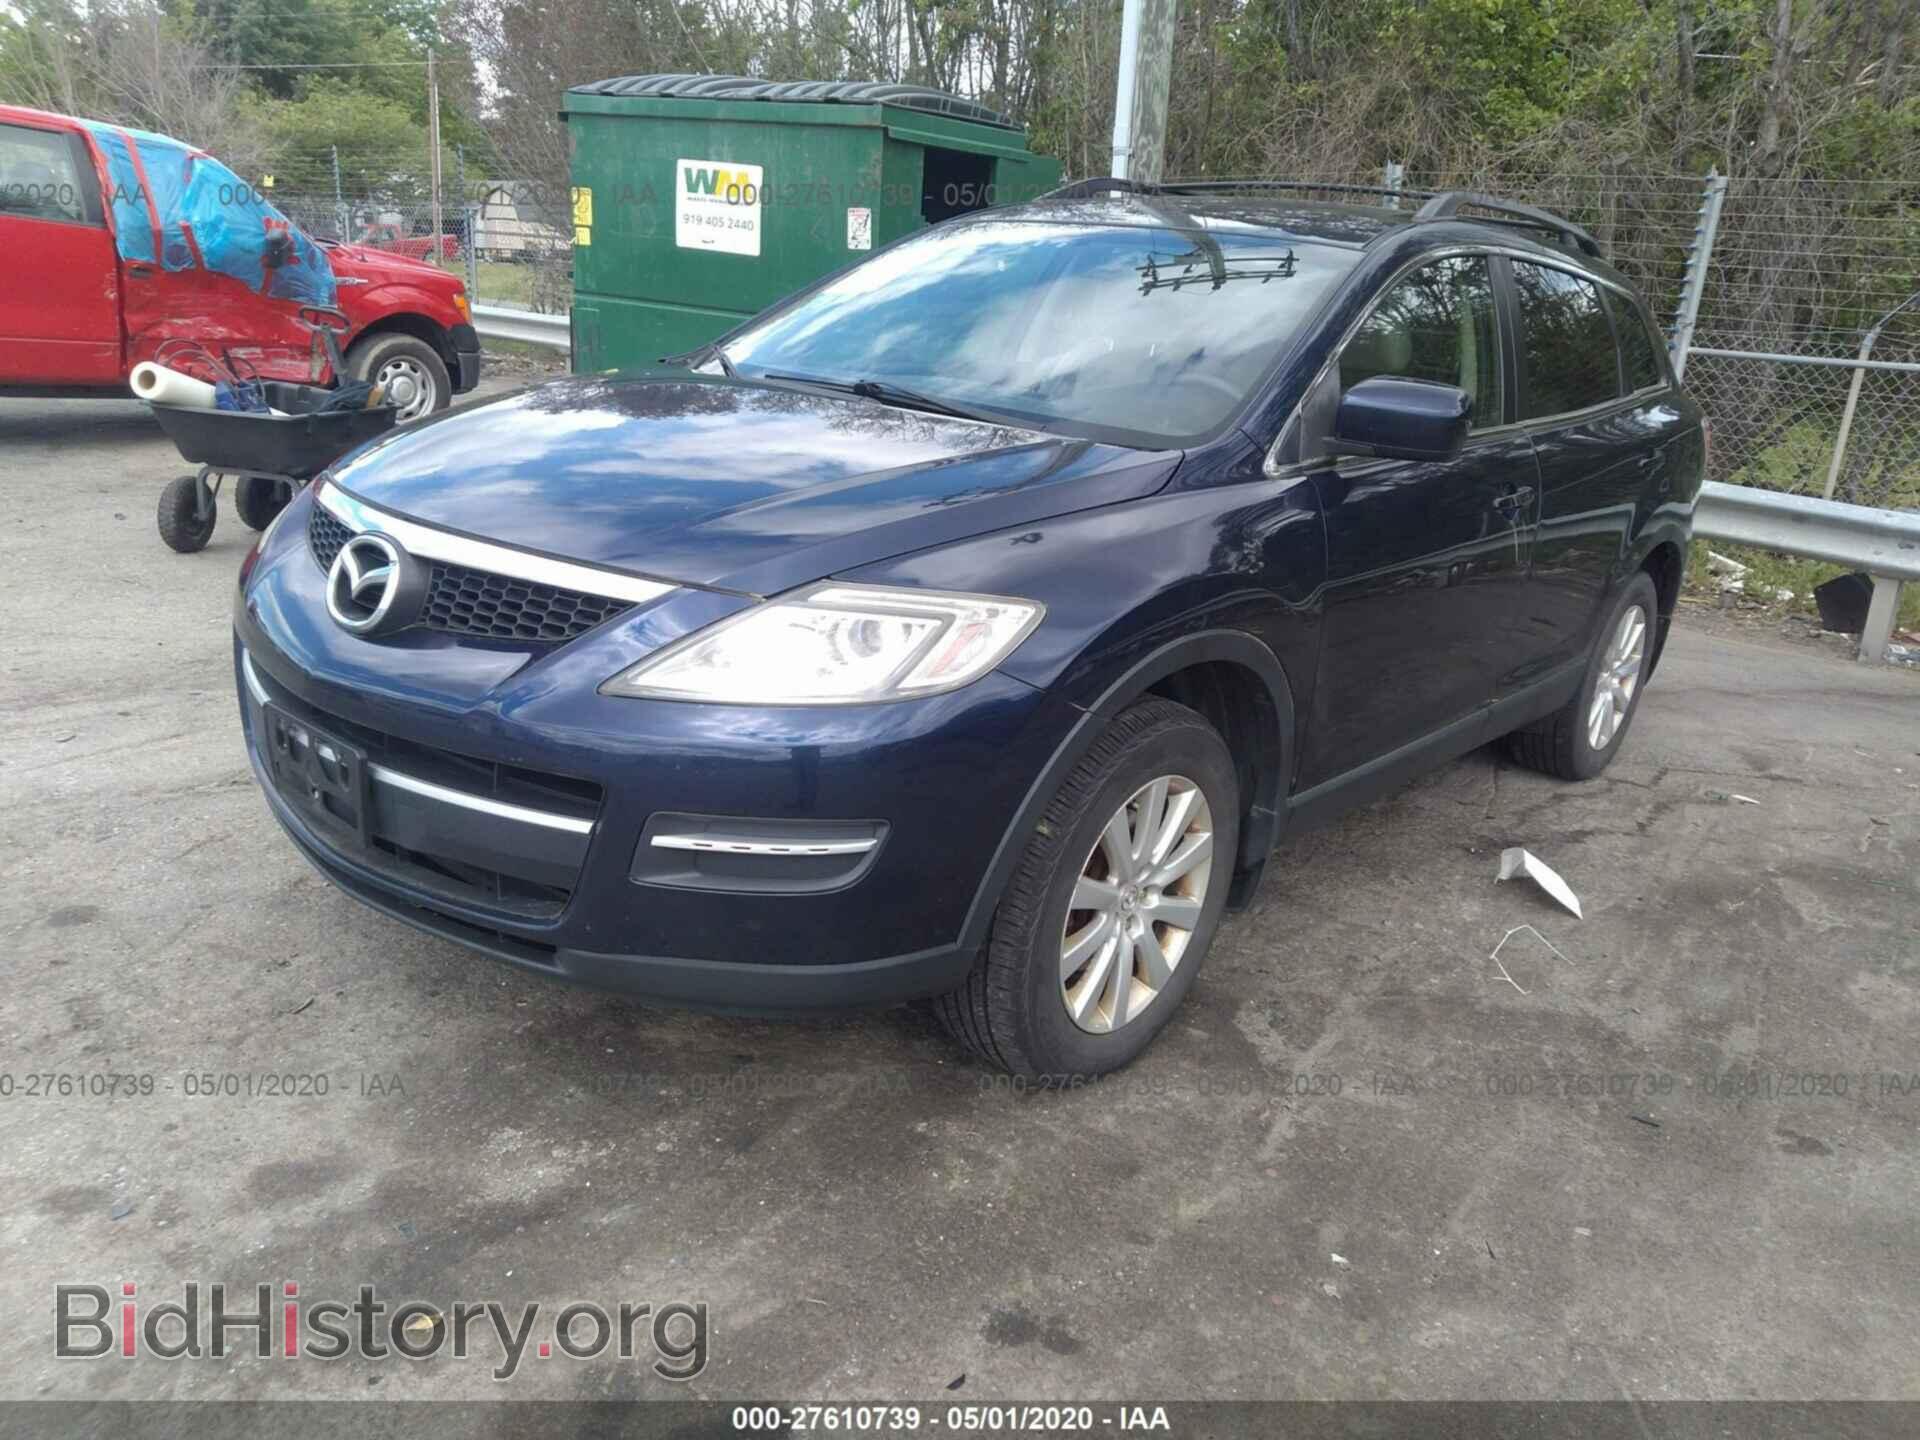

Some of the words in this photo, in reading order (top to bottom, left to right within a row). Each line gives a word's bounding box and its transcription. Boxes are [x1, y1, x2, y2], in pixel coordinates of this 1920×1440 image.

[683, 213, 703, 225] 919
[705, 215, 725, 228] 405
[727, 217, 754, 232] 2440
